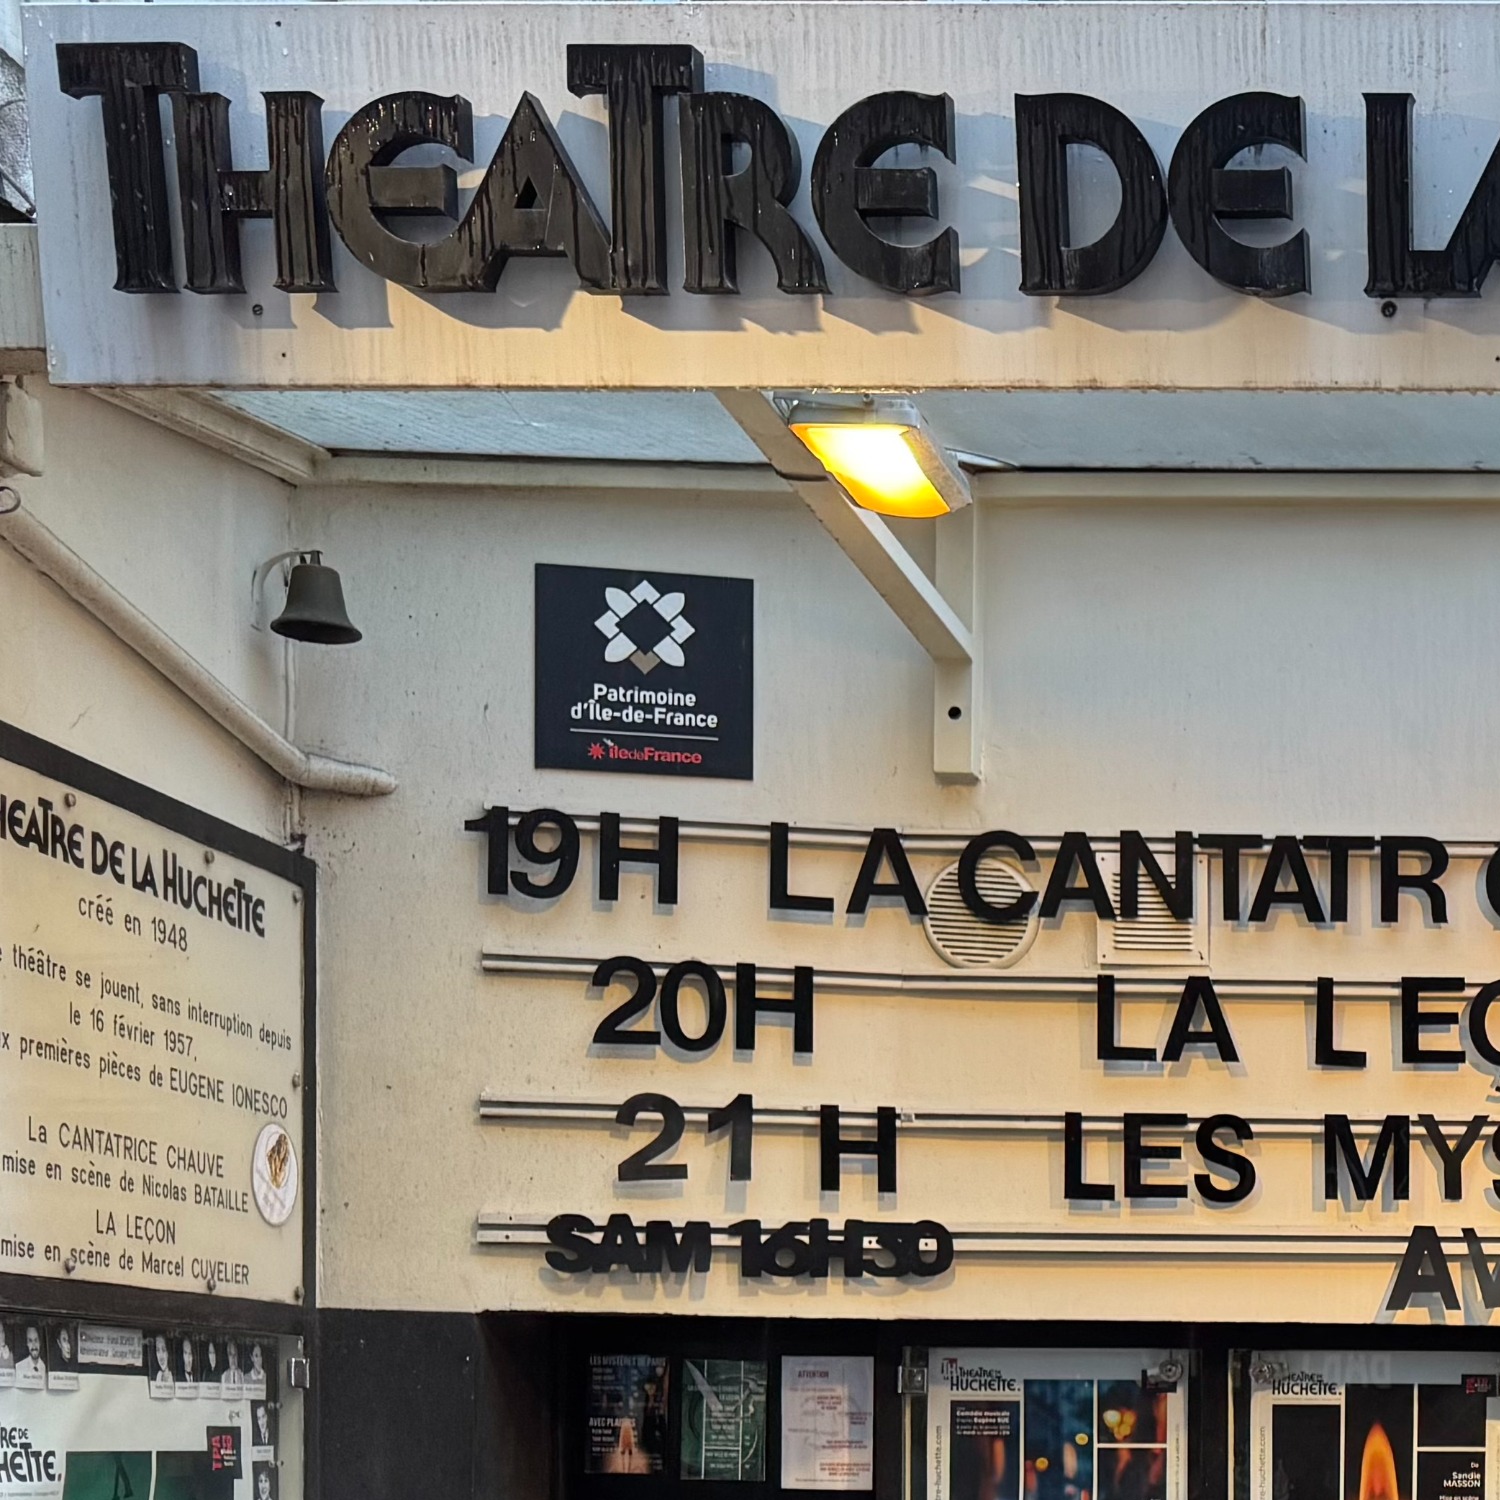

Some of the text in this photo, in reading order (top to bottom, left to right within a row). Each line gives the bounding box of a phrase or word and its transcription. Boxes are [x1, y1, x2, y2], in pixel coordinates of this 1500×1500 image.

[56, 42, 961, 296] THEATRE
[1014, 91, 1311, 296] DE
[593, 683, 696, 707] Patrimoine
[91, 831, 125, 885] DE
[132, 847, 159, 898] LA
[163, 849, 265, 938] HUCHETTE
[465, 806, 680, 905] 19H
[770, 822, 929, 917] LA
[78, 894, 188, 951] créé en 1948
[13, 944, 66, 981] théâtre
[76, 969, 91, 988] se
[152, 993, 181, 1016] sans
[188, 998, 252, 1039] interruption
[259, 1023, 291, 1050] depuis
[70, 1001, 81, 1026] le
[90, 1008, 104, 1032] 16
[113, 1014, 155, 1046] février
[591, 956, 813, 1053] 20H
[1097, 974, 1239, 1062] LA
[20, 1035, 91, 1069] premières
[99, 1050, 141, 1080] pièces
[149, 1065, 163, 1087] de
[170, 1067, 224, 1103] EUGENE
[232, 1083, 287, 1119] IONESCO
[28, 1115, 224, 1179] La CANTATRICE CHAUVE
[1064, 1112, 1256, 1203] LES
[2, 1150, 249, 1214] mise en scène de Nicolas BATAILLE
[96, 1209, 176, 1244] LA LEÇON
[545, 1213, 711, 1273] SAM
[1, 1234, 249, 1286] mise en scène de Marcel CUVELIER
[1443, 1480, 1480, 1488] MASSON
